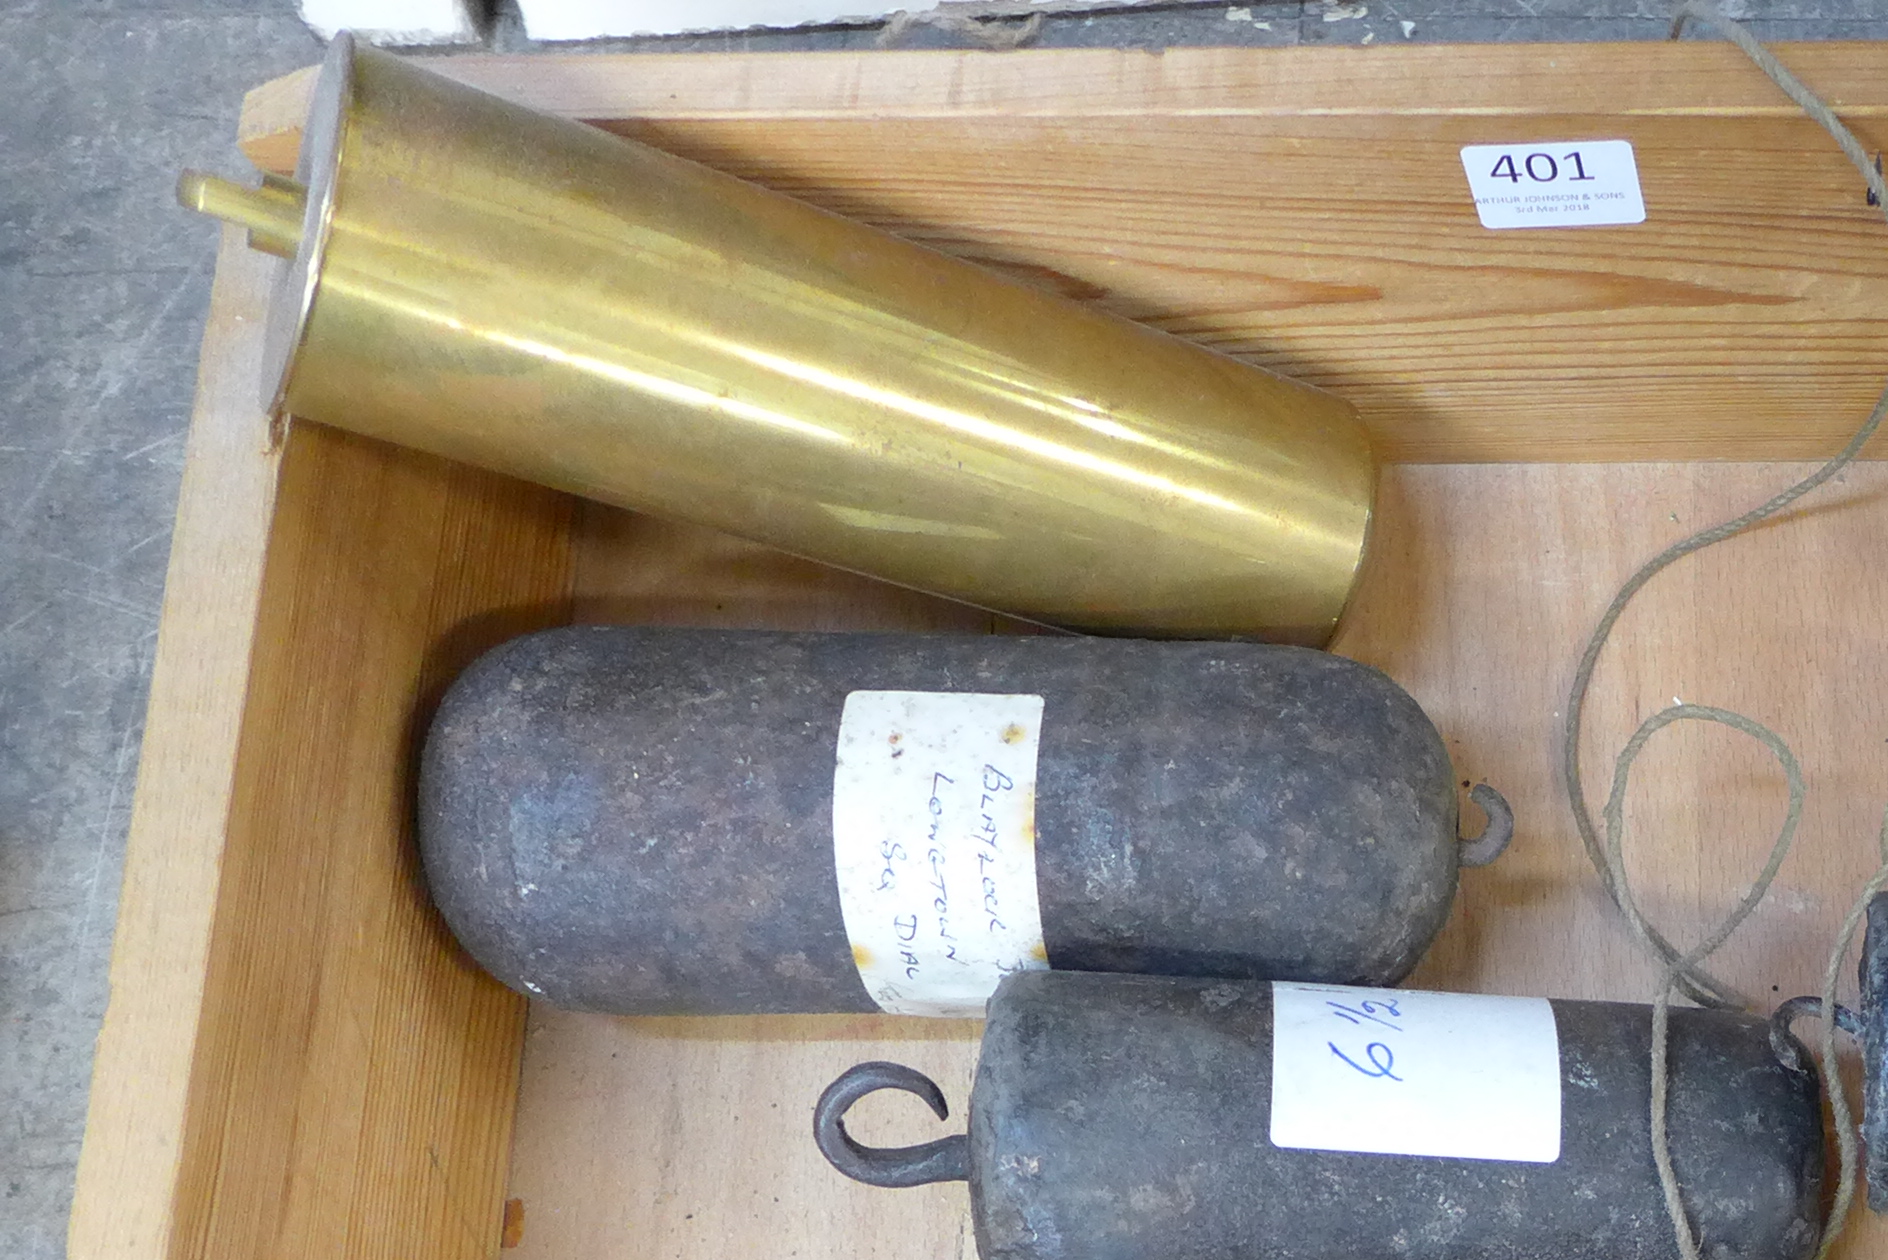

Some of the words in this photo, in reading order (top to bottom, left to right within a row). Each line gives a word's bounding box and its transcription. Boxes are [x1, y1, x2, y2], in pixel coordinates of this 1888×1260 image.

[1490, 151, 1595, 183] 401
[1475, 196, 1521, 205] ARTHUR
[1524, 194, 1579, 203] JOHNSON
[1582, 193, 1591, 201] &
[1594, 192, 1625, 200] SONS
[1536, 205, 1559, 213] Mar
[893, 914, 920, 981] DIAL
